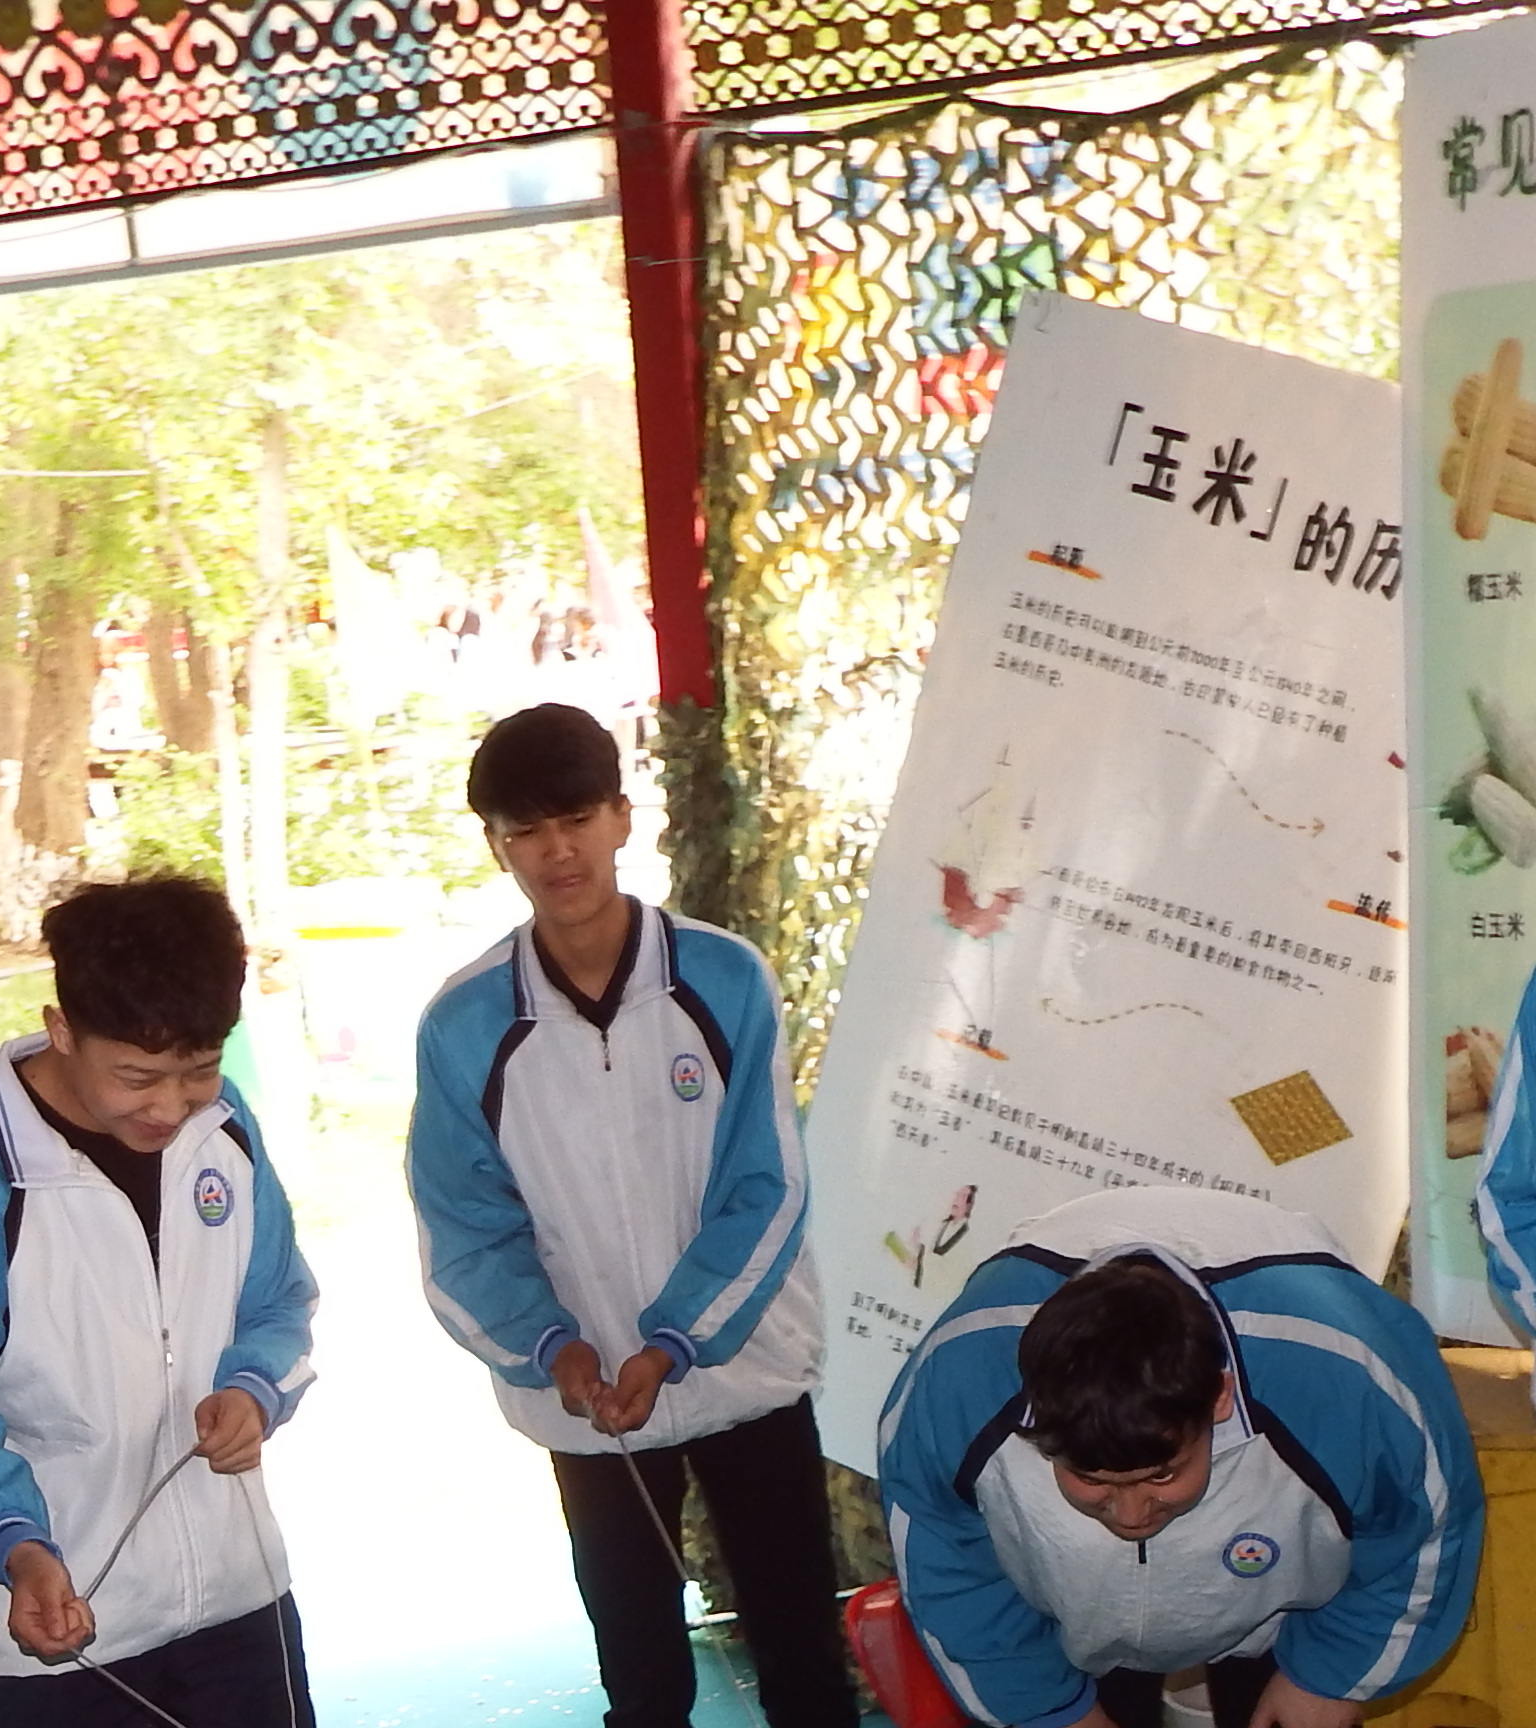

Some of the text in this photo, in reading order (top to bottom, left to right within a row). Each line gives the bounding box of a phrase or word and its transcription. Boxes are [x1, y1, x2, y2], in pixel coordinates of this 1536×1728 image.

[1107, 401, 1402, 601] 「玉米」的历
[1471, 912, 1525, 941] 白玉米
